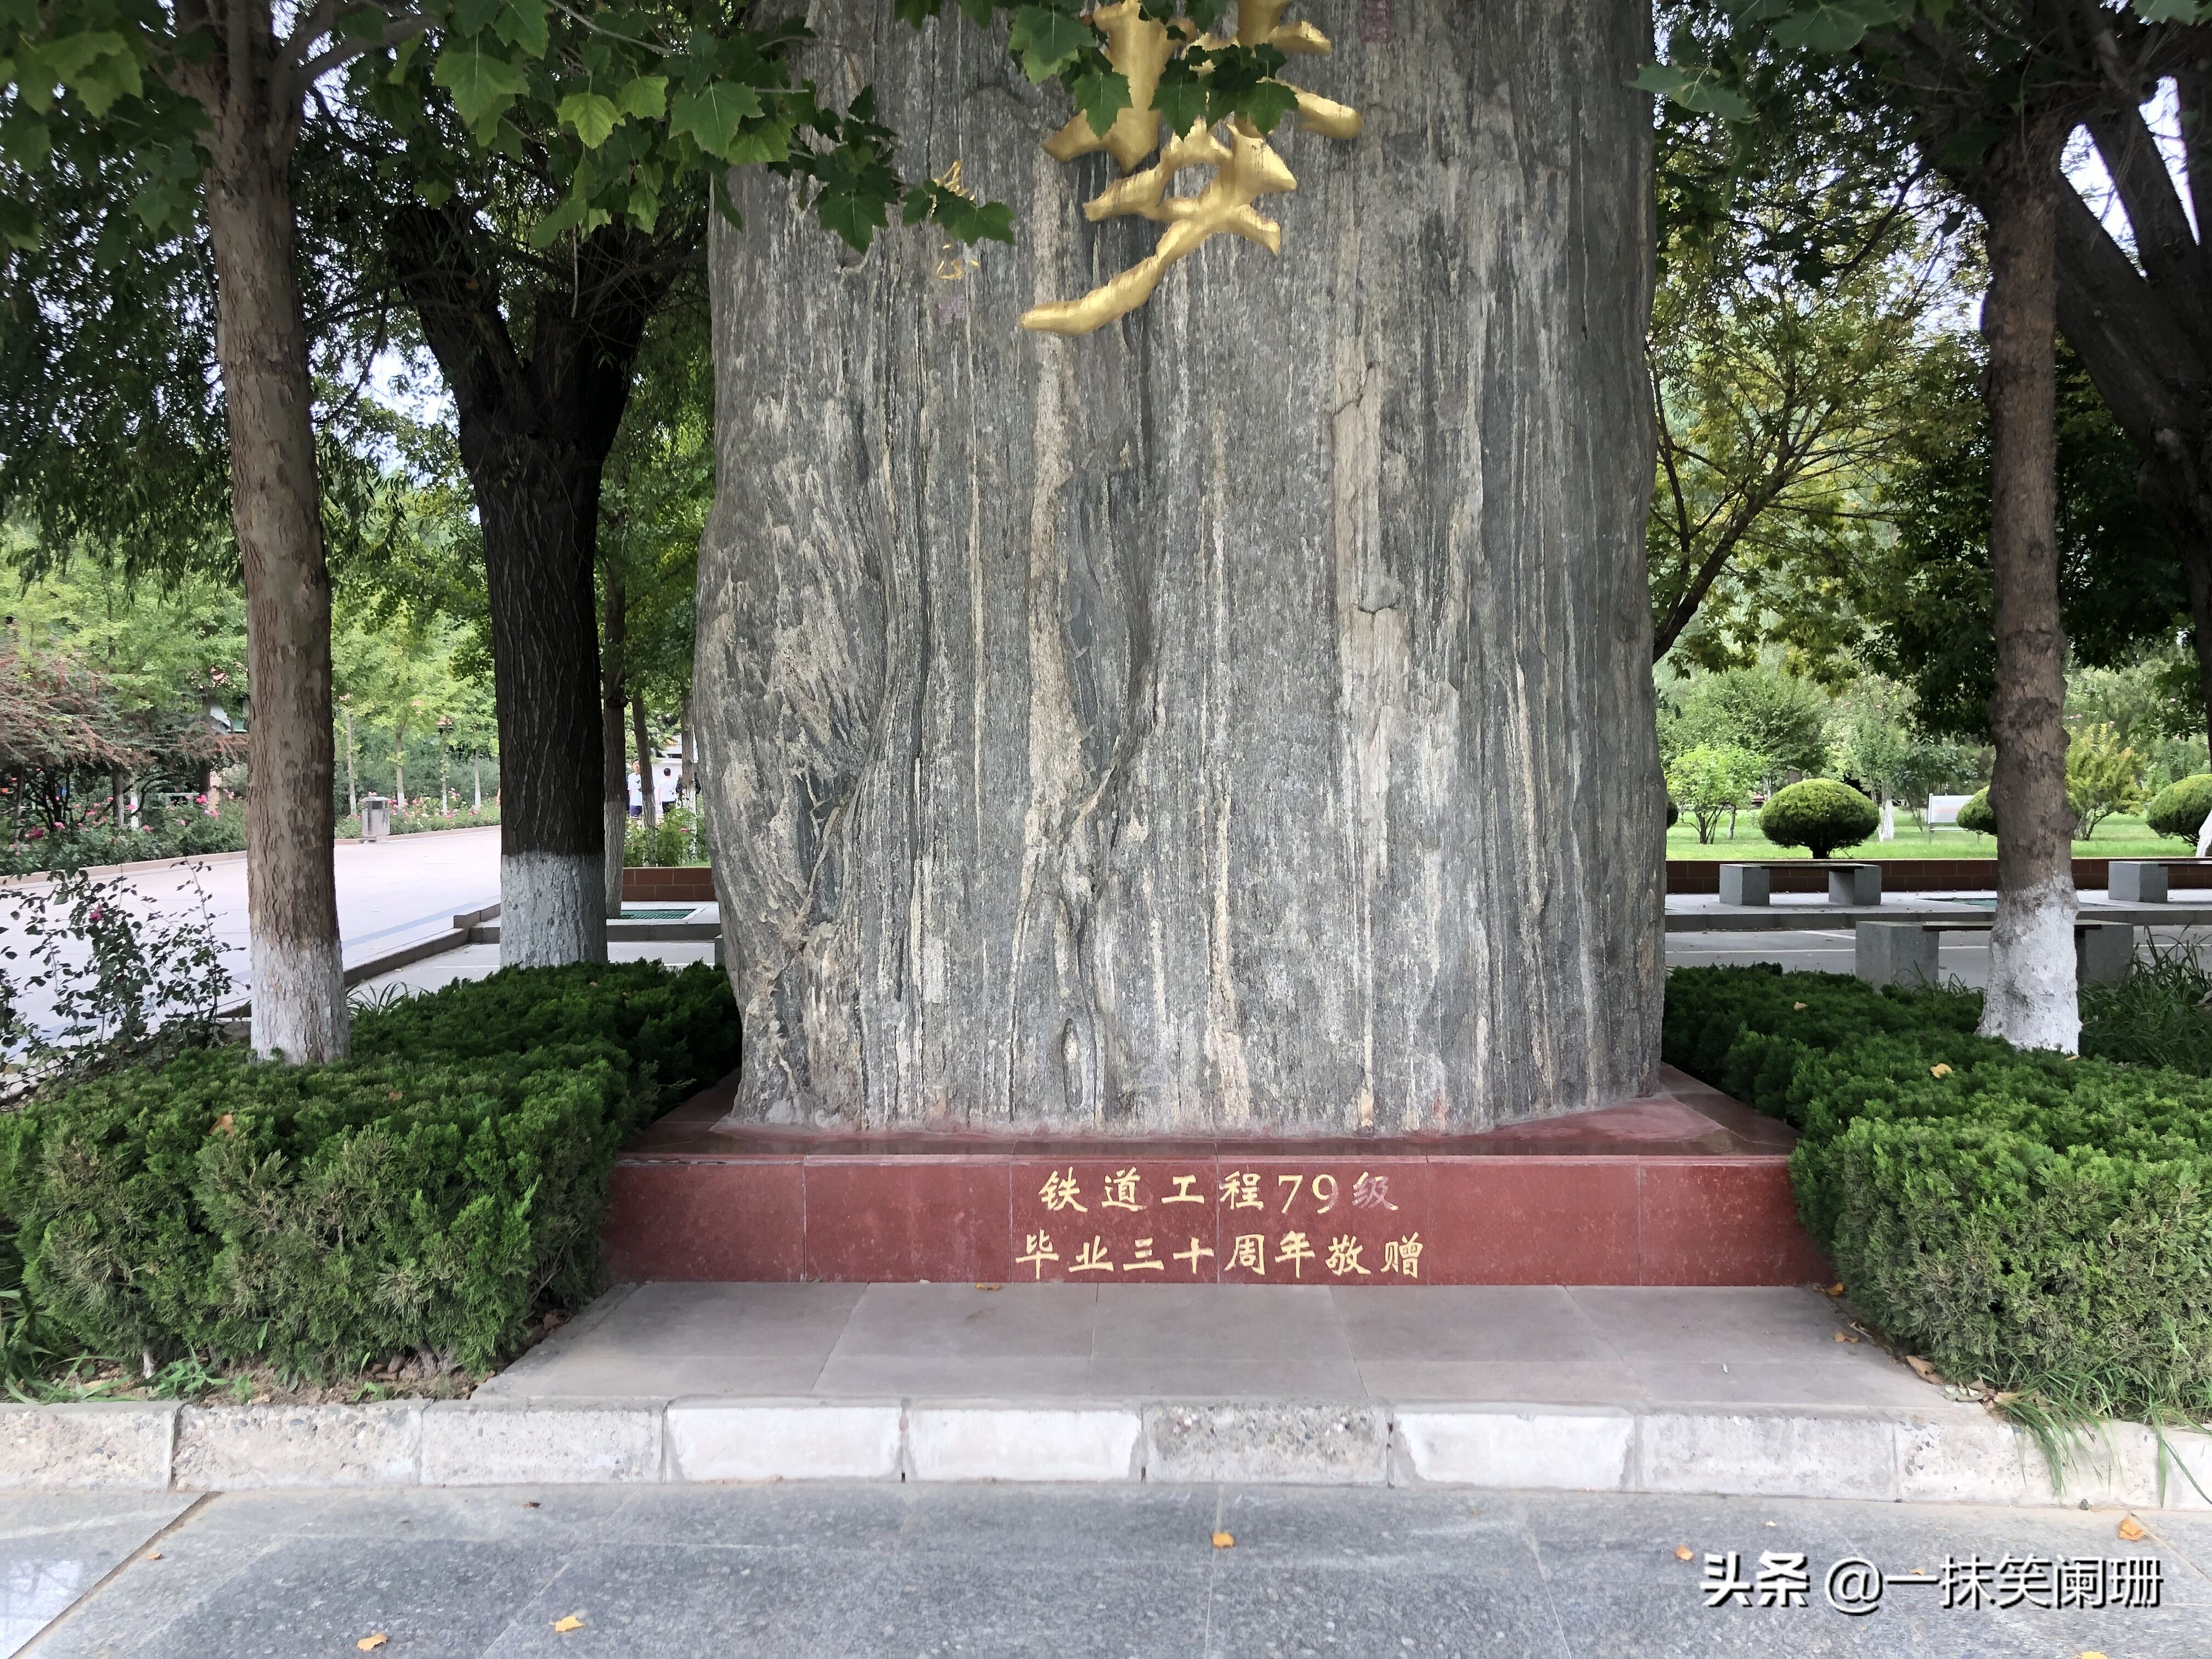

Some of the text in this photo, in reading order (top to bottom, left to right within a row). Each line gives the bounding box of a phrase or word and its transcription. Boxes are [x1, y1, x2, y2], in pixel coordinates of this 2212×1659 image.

[1039, 1166, 1398, 1214] 铁道工程79级
[1015, 1229, 1423, 1279] 毕业三十周年敬赠
